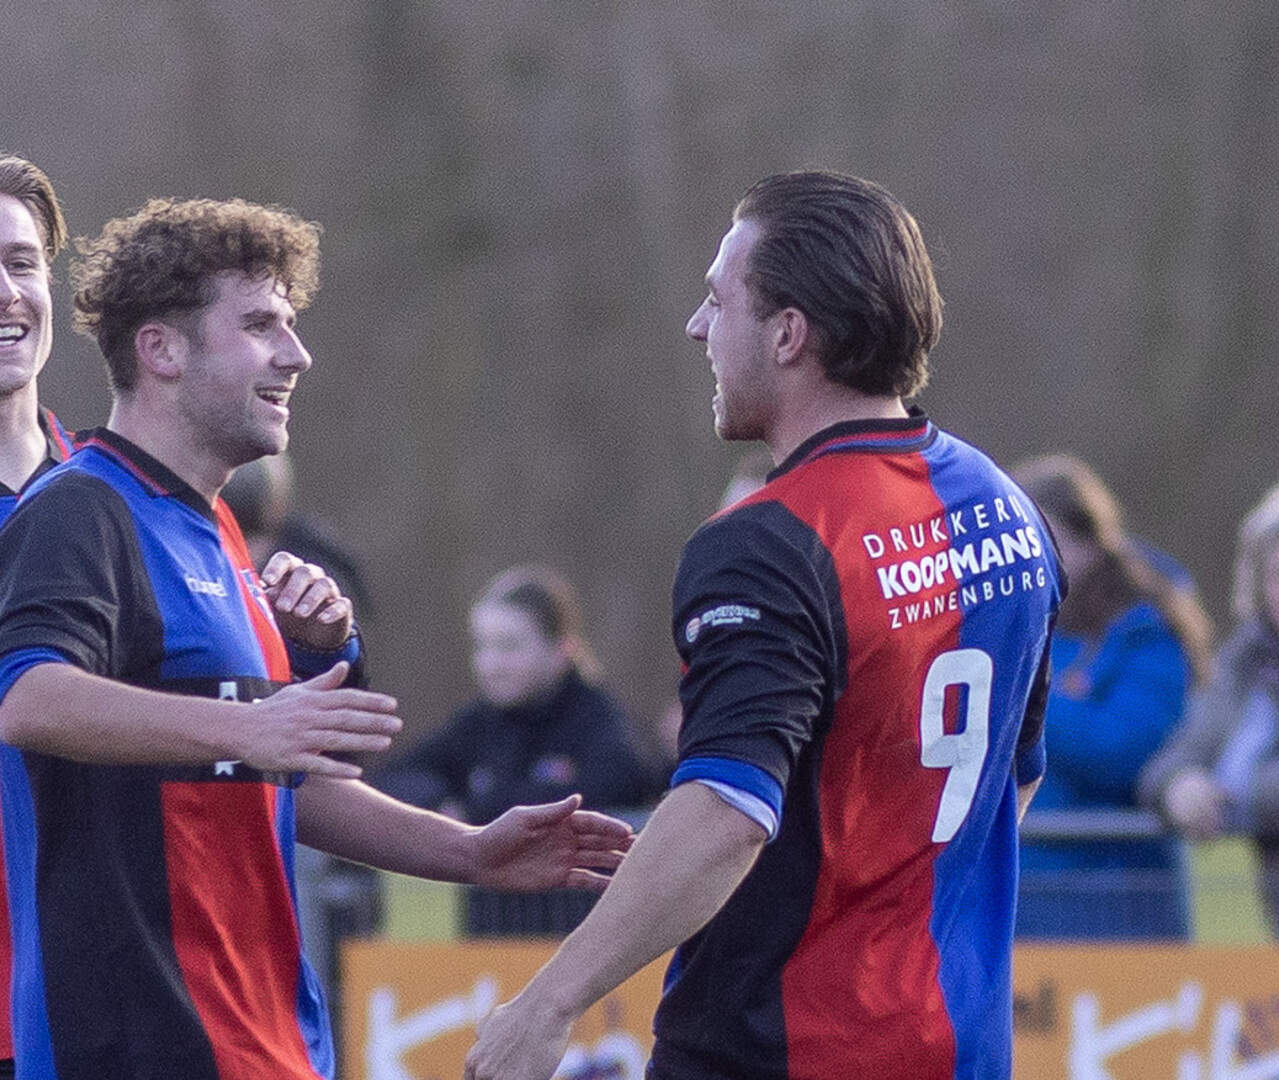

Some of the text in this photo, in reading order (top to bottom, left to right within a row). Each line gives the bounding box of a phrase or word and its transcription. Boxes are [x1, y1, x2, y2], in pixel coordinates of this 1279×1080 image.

[862, 494, 1029, 559] DRUKKERIJ
[877, 525, 1042, 600] KOOPMANS
[887, 566, 1046, 630] ZWANENBURG
[920, 648, 994, 843] 9
